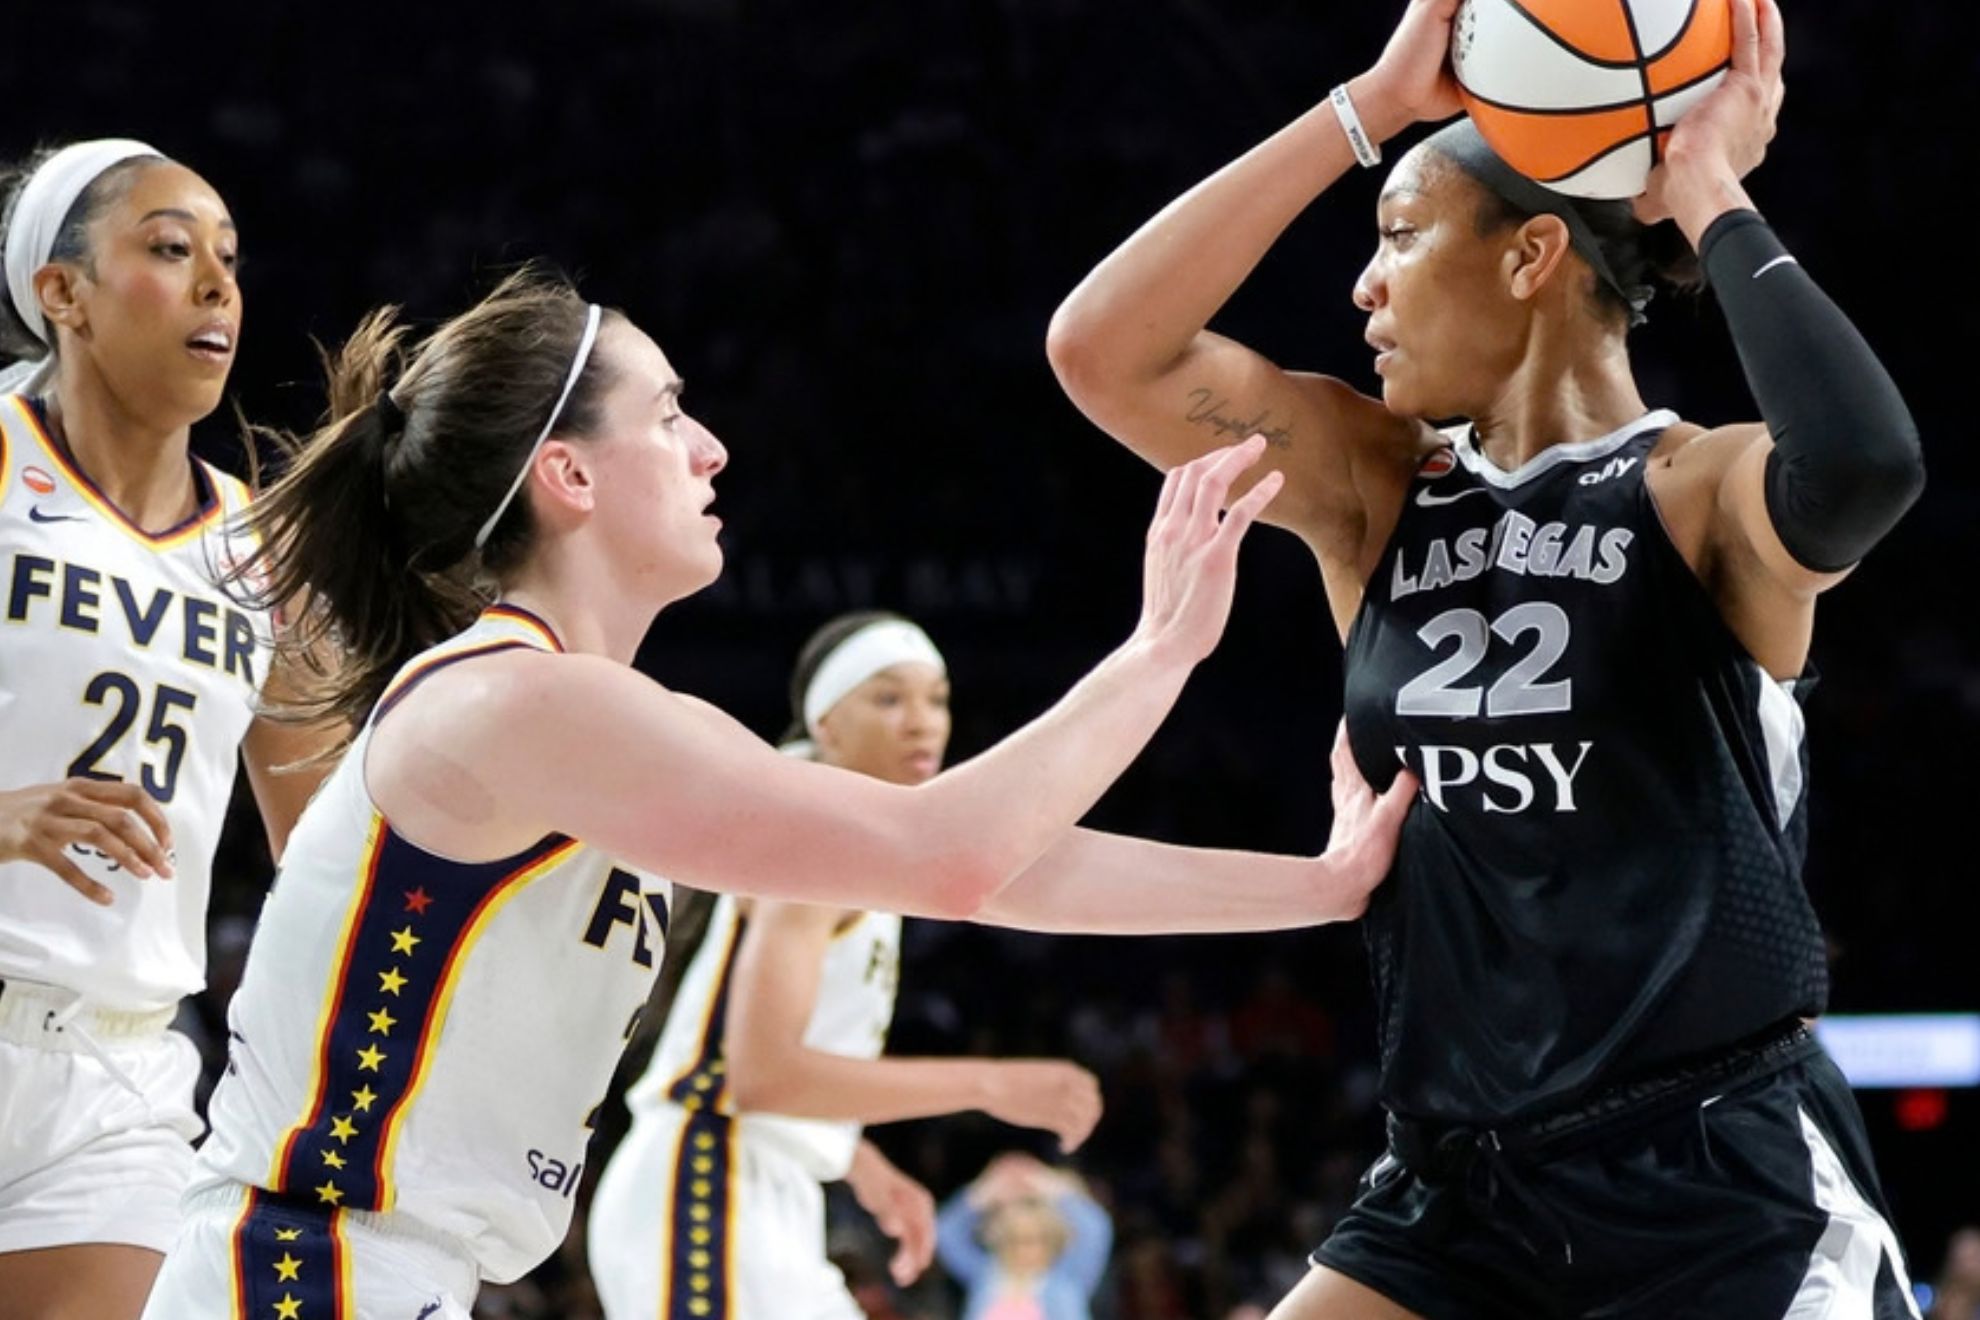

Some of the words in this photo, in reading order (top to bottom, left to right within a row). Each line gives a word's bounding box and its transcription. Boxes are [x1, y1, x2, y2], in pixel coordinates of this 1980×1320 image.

[1578, 456, 1638, 486] ally
[1390, 527, 1488, 602] LAS
[6, 553, 257, 684] FEVER
[1395, 601, 1571, 719] 22
[66, 671, 197, 803] 25
[1394, 741, 1593, 813] PSY
